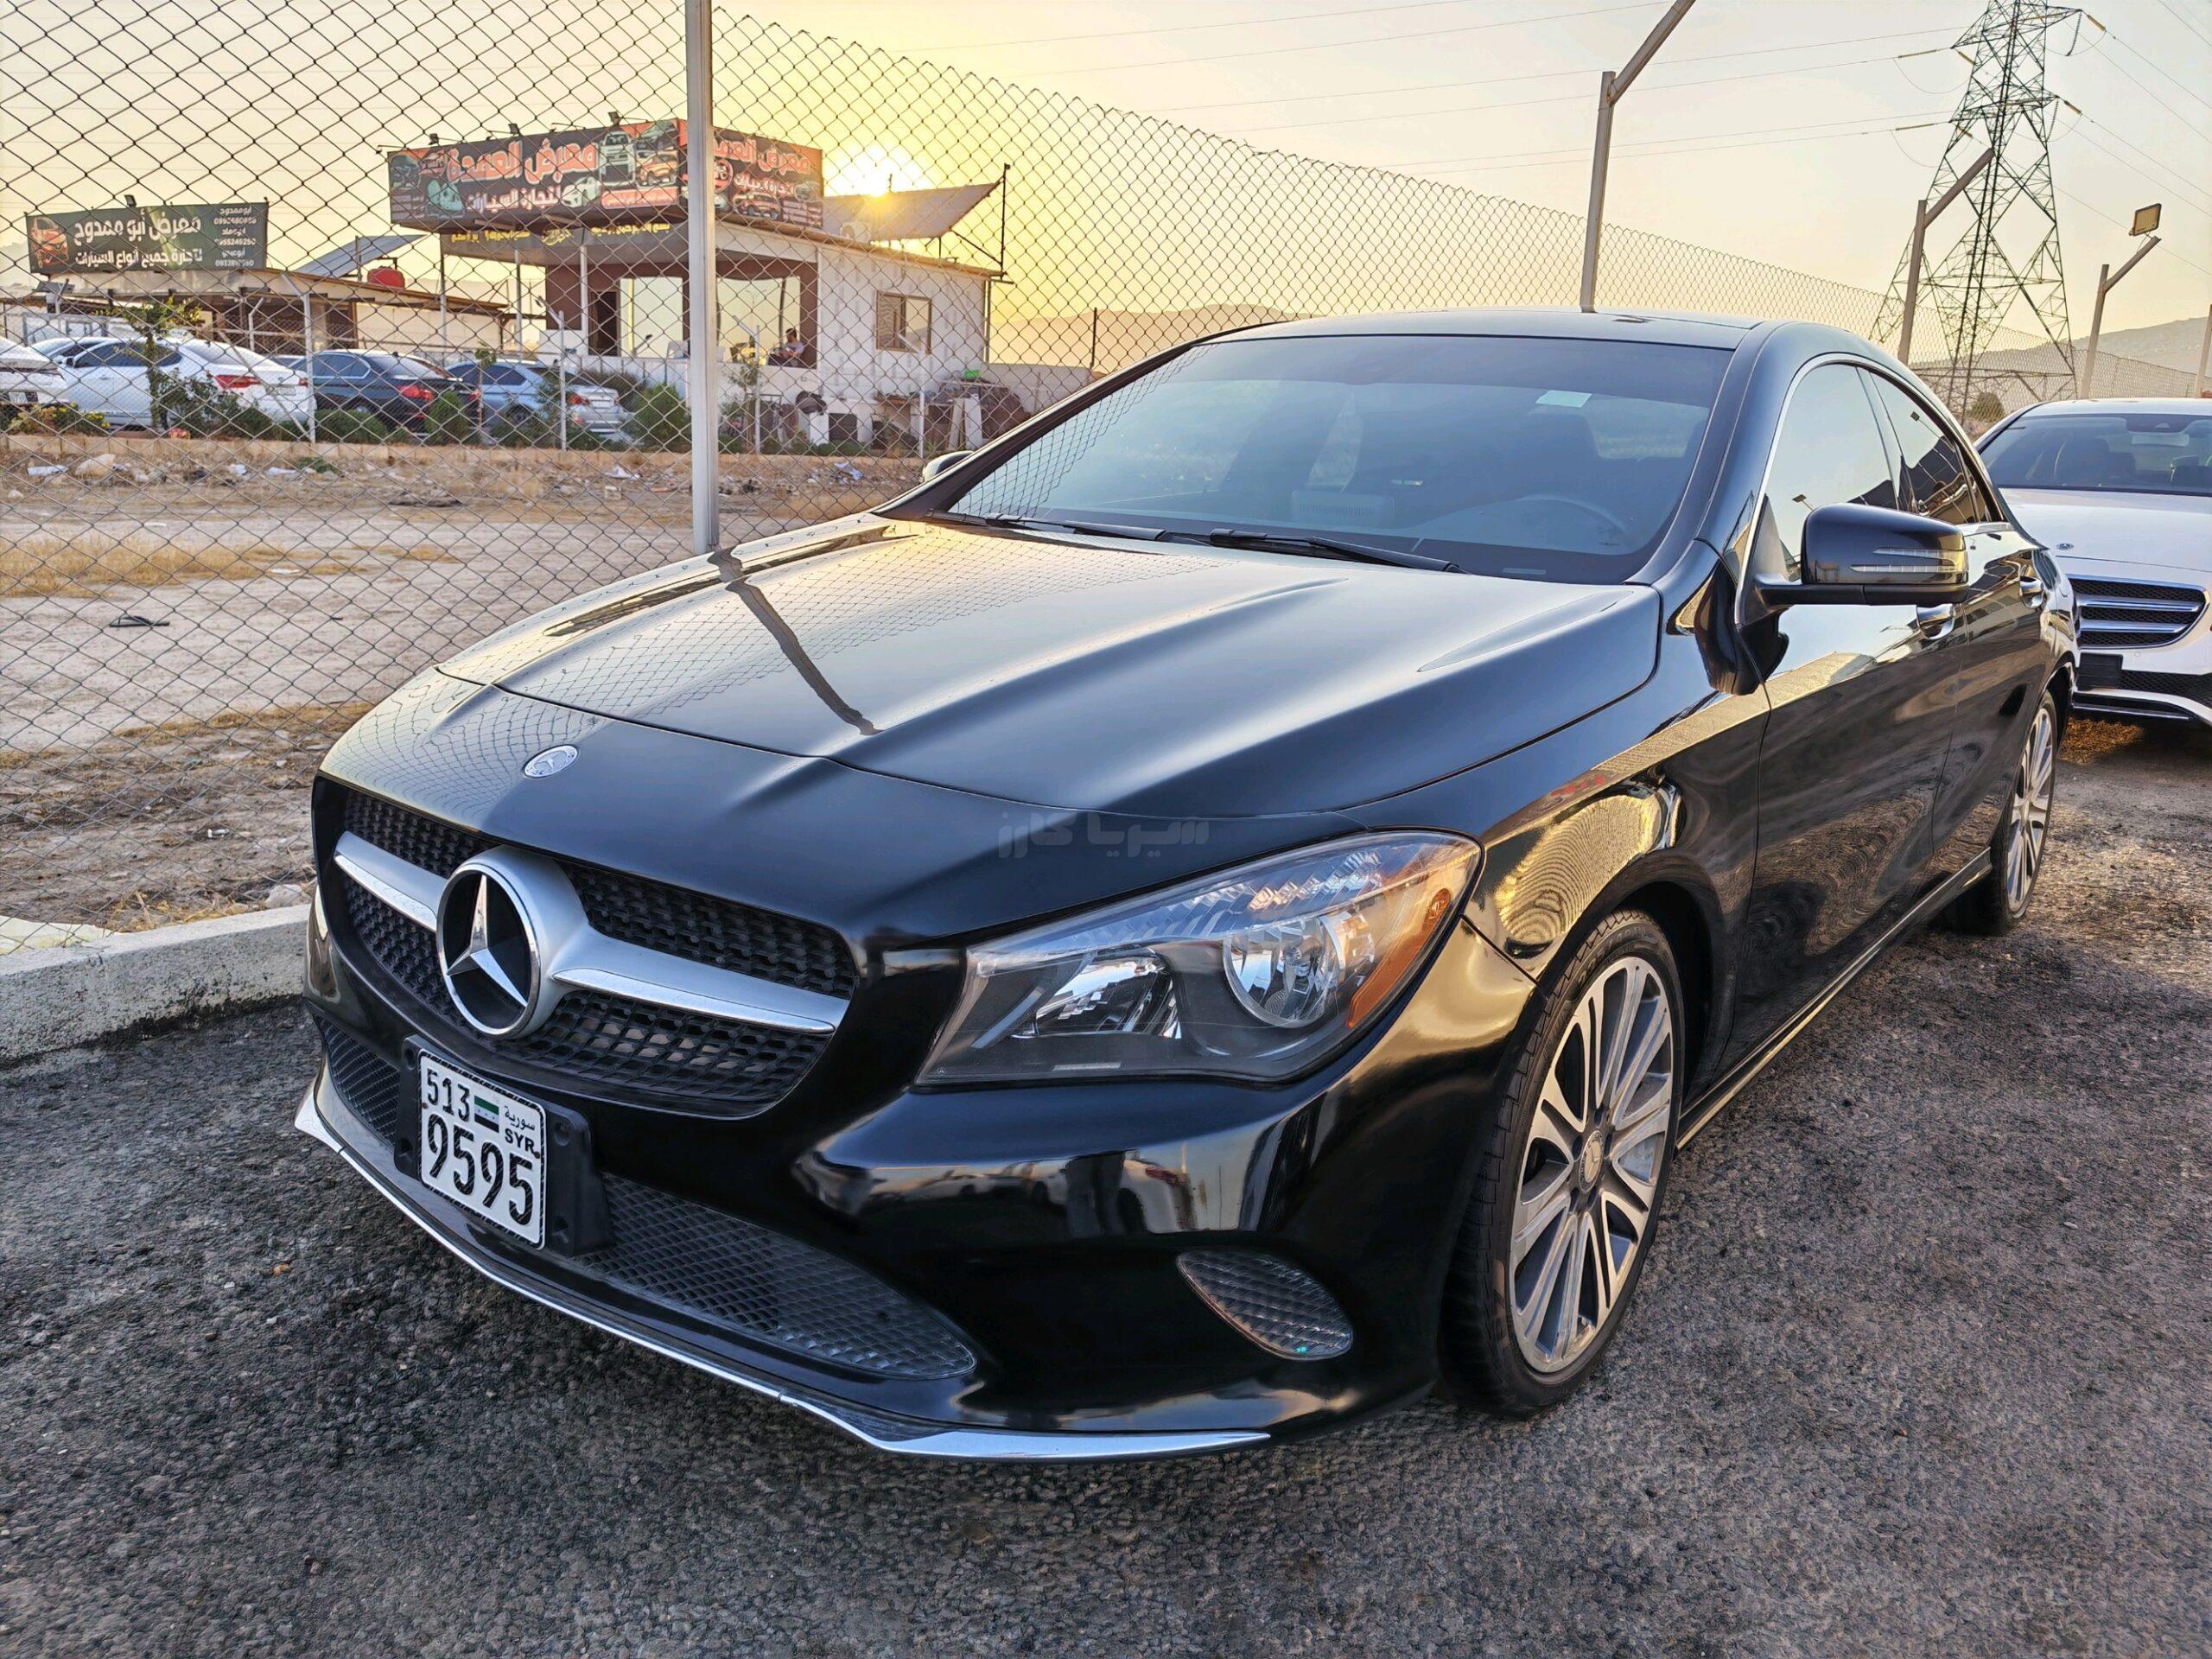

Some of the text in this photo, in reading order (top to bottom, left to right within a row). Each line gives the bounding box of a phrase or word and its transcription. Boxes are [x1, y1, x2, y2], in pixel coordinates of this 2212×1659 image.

[447, 137, 599, 184] معرض العمدة
[518, 185, 561, 210] لتجارة
[73, 208, 201, 246] معرض أبو ممدوح
[75, 246, 202, 269] لتجارة جميع أنواع السيارات
[427, 1068, 470, 1122] 513
[504, 1105, 536, 1131] سورية
[505, 1128, 536, 1155] SYR
[428, 1113, 533, 1226] 9595
